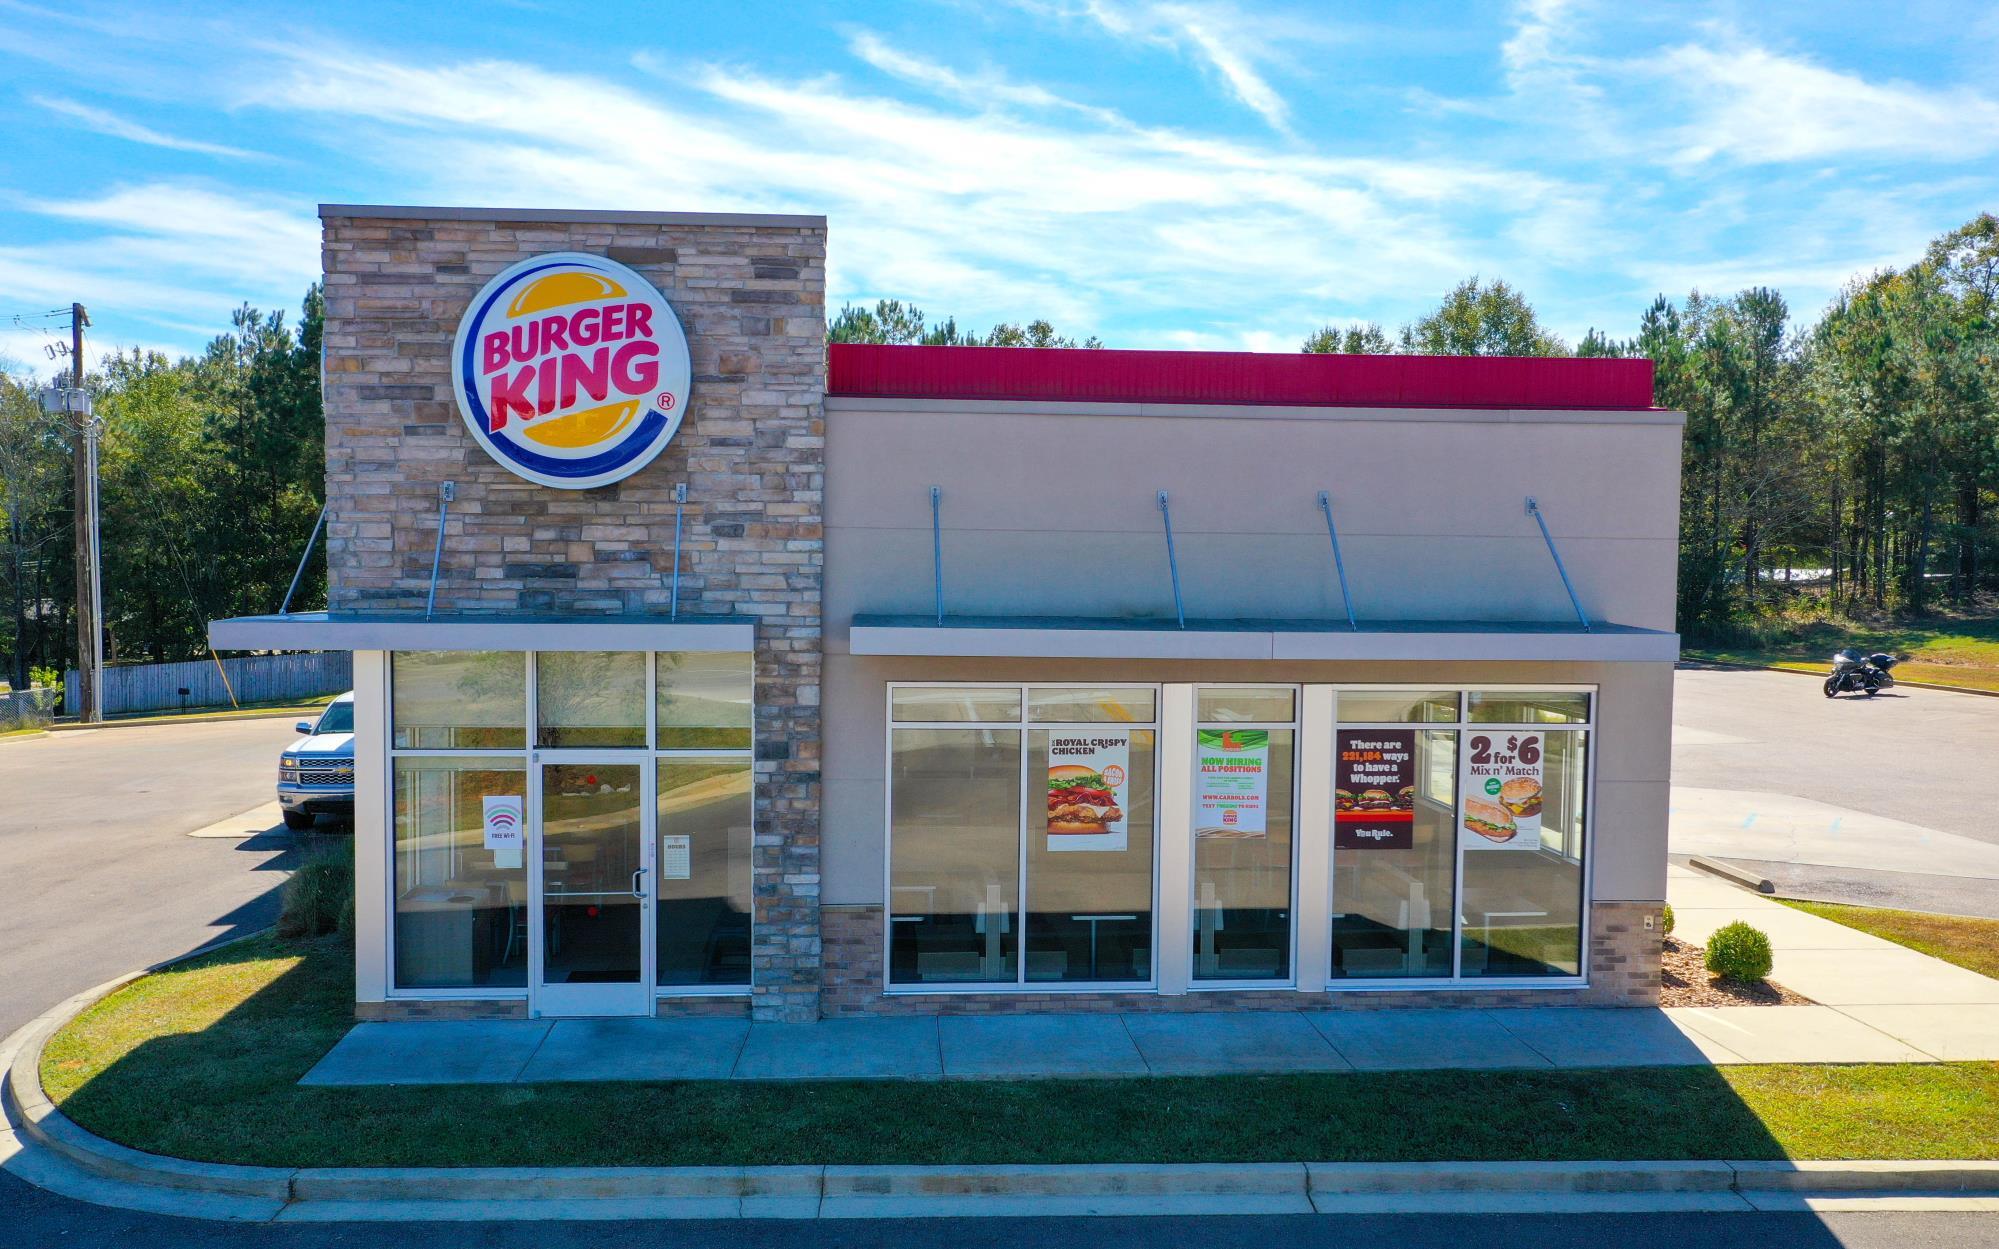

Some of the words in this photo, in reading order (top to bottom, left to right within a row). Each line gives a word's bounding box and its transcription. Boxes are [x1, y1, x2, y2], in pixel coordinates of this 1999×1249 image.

[483, 303, 653, 375] BURGER
[490, 340, 660, 432] KING
[1056, 738, 1089, 747] ROYAL
[1090, 738, 1128, 749] CRISPY
[1350, 740, 1382, 750] There
[1383, 741, 1402, 750] are
[1052, 747, 1095, 755] CHICKEN
[1470, 735, 1492, 765] 2
[1494, 752, 1516, 764] for
[1507, 735, 1540, 765] $6
[1201, 757, 1224, 766] NOW
[1226, 757, 1263, 766] HIRING
[1342, 751, 1381, 762] 221,184
[1383, 752, 1409, 763] ways
[1201, 765, 1217, 773] ALL
[1218, 765, 1263, 773] POSITIONS
[1353, 763, 1364, 772] to
[1365, 763, 1389, 772] have
[1391, 764, 1398, 772] a
[1470, 766, 1491, 775] Mix
[1505, 766, 1539, 775] Match
[1355, 829, 1371, 837] You
[1371, 829, 1393, 840] Rule.
